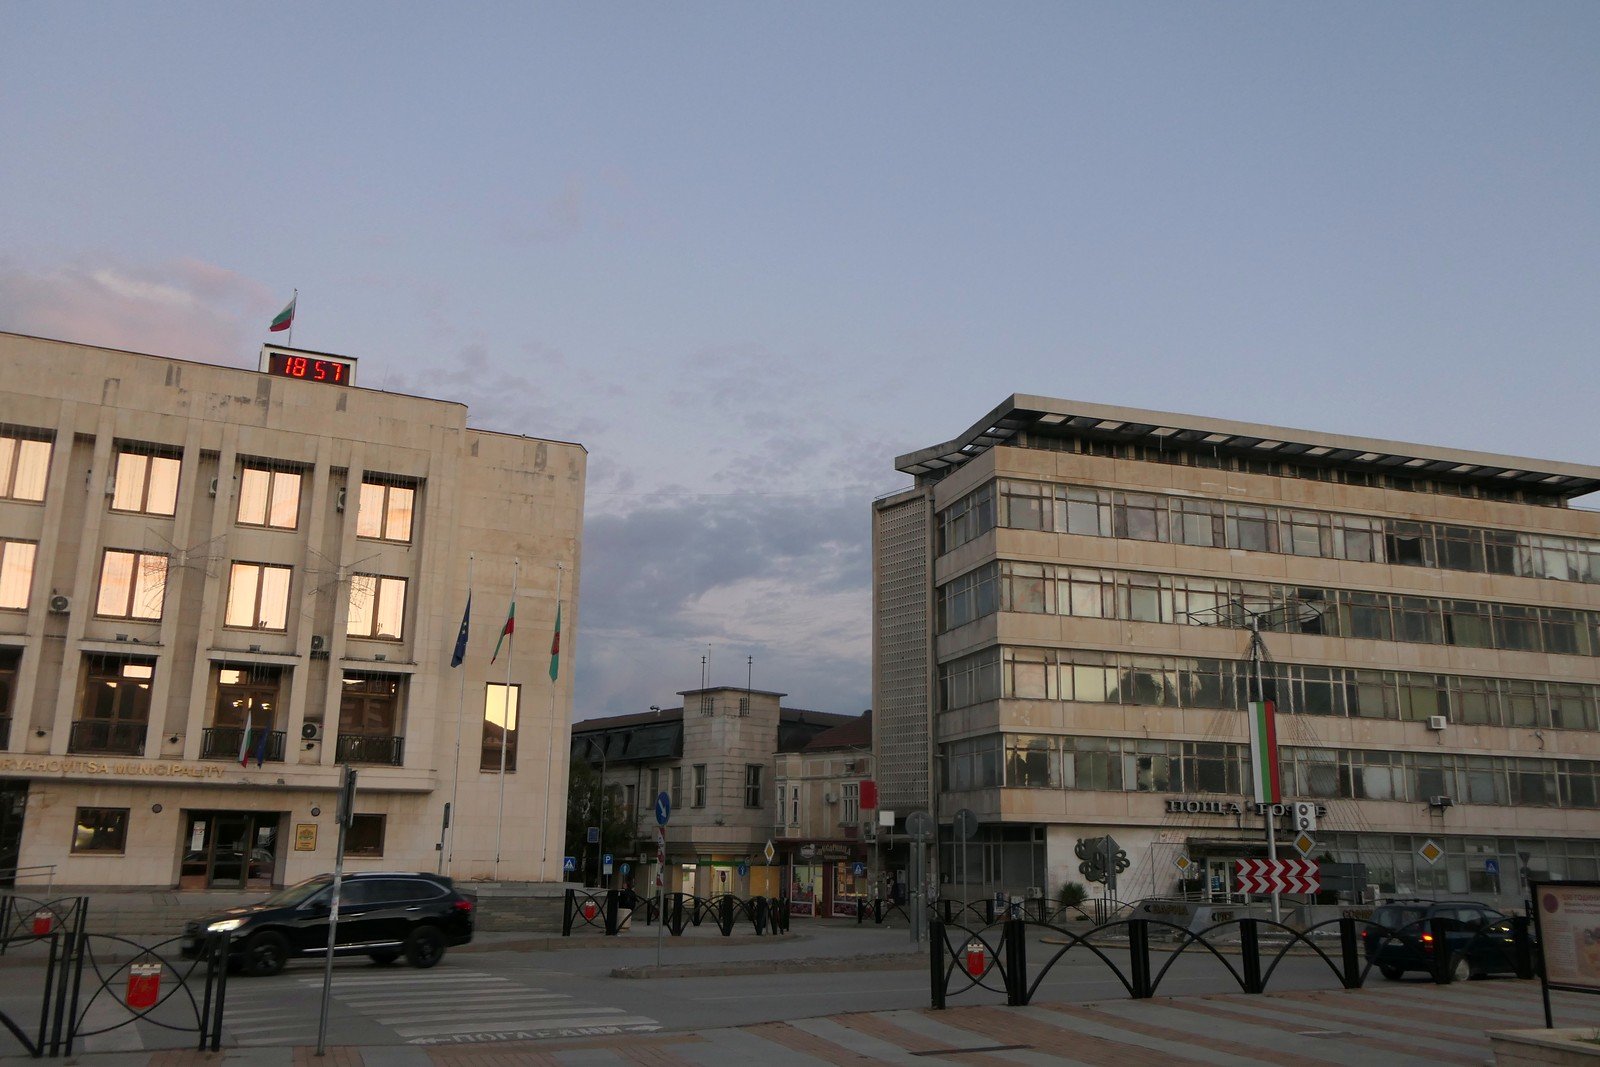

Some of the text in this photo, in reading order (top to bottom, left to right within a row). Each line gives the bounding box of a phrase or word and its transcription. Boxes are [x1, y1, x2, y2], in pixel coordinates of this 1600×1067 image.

[285, 357, 343, 382] 18 57
[113, 762, 226, 778] MUNICIPALITY
[1166, 800, 1242, 815] ПОЩА
